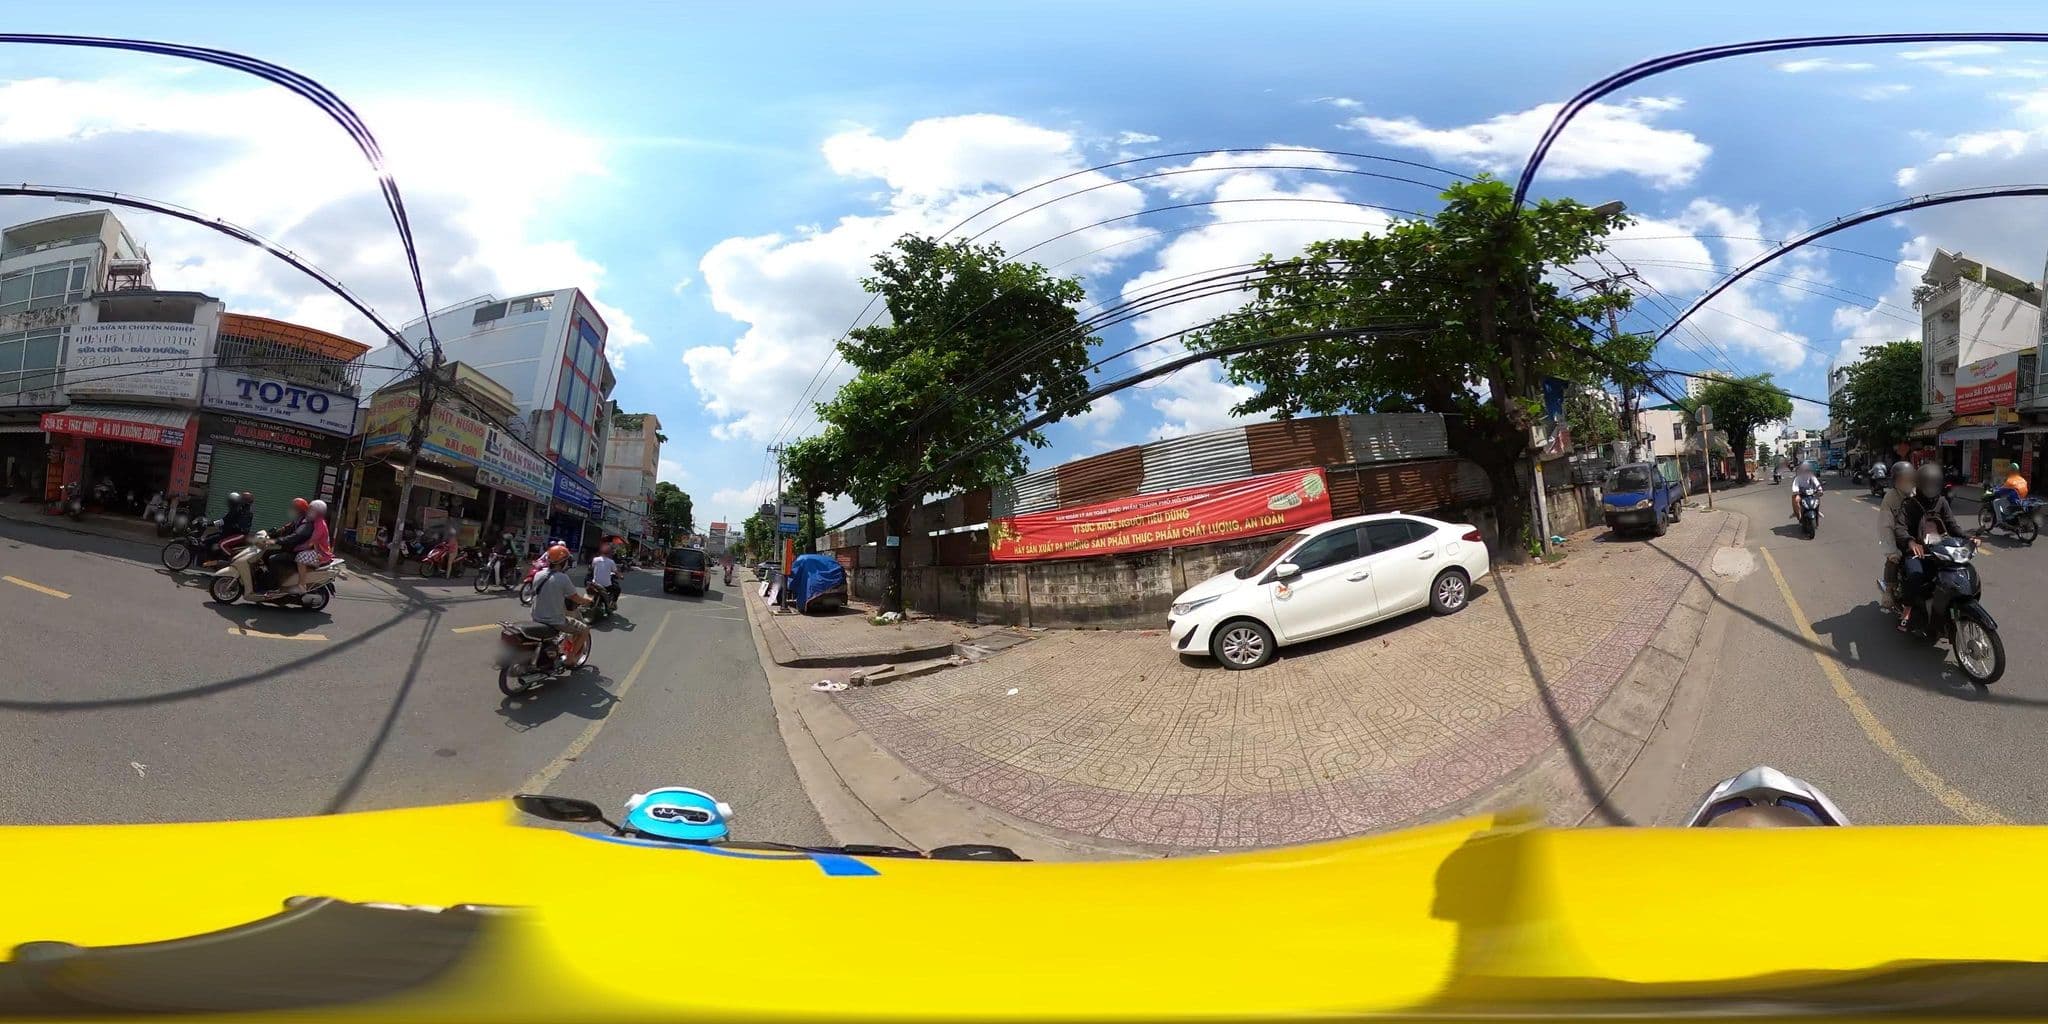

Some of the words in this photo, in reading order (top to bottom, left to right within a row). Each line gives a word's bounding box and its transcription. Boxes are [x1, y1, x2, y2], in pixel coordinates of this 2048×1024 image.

[78, 345, 95, 353] SỬA
[130, 345, 150, 353] BẢO
[236, 379, 329, 414] TOTO
[1026, 542, 1037, 554] SẢN
[1038, 540, 1054, 553] XUẤT
[1065, 537, 1090, 550] NHỮNG
[1091, 535, 1106, 549] SẢN
[1108, 531, 1130, 547] PHẨM
[1132, 531, 1153, 546] THỰC
[1155, 524, 1180, 540] PHẨM
[1182, 520, 1207, 537] CHẤT
[1208, 519, 1243, 536] LƯỢNG,
[1245, 516, 1258, 529] AN
[1260, 511, 1284, 526] TOÀN
[1081, 518, 1096, 533] SỨC
[1118, 514, 1146, 529] NGƯỜI
[1147, 511, 1162, 524] TIÊU
[1165, 508, 1190, 522] DÙNG
